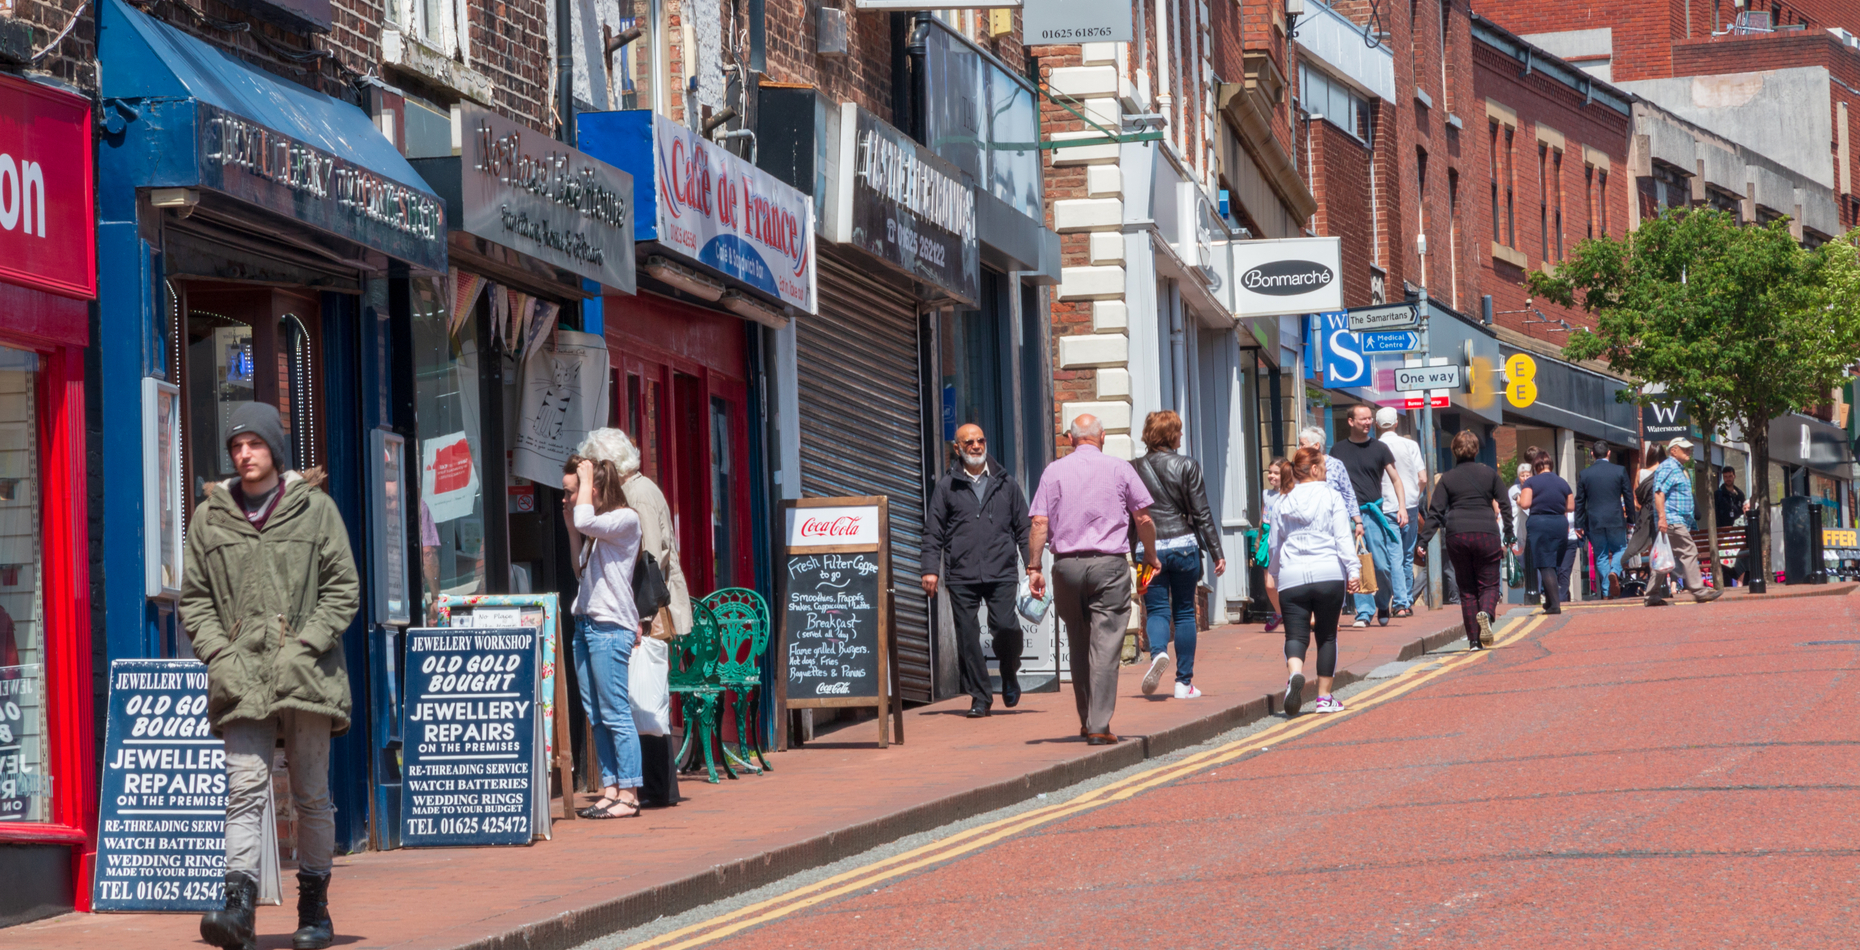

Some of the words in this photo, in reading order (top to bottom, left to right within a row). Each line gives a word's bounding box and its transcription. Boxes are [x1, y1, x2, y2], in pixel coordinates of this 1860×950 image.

[1042, 28, 1073, 39] 01625
[1075, 27, 1112, 38] 618765
[672, 137, 712, 218] Café
[718, 160, 738, 230] de
[742, 175, 799, 260] France
[897, 223, 918, 255] 01625
[919, 235, 945, 268] 262122
[1245, 268, 1331, 289] Bonmarché
[1350, 316, 1364, 325] The
[1366, 312, 1408, 324] Samaritans
[1400, 373, 1424, 384] One
[1429, 372, 1454, 384] way
[1649, 400, 1681, 424] W
[1822, 529, 1858, 547] FFER
[787, 555, 821, 580] Fresh
[823, 554, 853, 569] Filter
[853, 555, 879, 576] Coffee
[820, 570, 830, 579] to
[831, 571, 841, 582] go
[805, 612, 862, 635] Breakfast
[824, 629, 833, 638] all
[412, 636, 472, 652] JEWELLERY
[474, 634, 532, 650] WORKSHOP
[789, 641, 812, 657] Flame
[813, 642, 836, 658] grilled
[422, 655, 463, 674] OLD
[466, 654, 521, 673] GOLD
[789, 655, 800, 665] Hot
[820, 655, 839, 666] Fries
[115, 673, 184, 690] JEWELLERY
[428, 673, 516, 692] BOUGHT
[789, 666, 828, 683] Baguettes
[831, 668, 838, 677] &
[126, 694, 172, 715] OLD
[175, 694, 209, 715] GO
[410, 701, 530, 721] JEWELLERY
[131, 717, 211, 737] BOUGH
[424, 723, 515, 742] REPAIRS
[418, 744, 437, 753] ON
[441, 743, 461, 753] THE
[465, 741, 520, 752] PREMISES
[109, 749, 226, 770] JEWELLER
[408, 763, 484, 776] RE-THREADING
[486, 762, 529, 775] SERVICE
[124, 773, 226, 794] REPAIRS
[408, 780, 455, 791] WATCH
[457, 778, 528, 790] BATTERIES
[116, 795, 137, 806] ON
[142, 795, 164, 806] THE
[412, 794, 480, 806] WEDDING
[482, 793, 524, 805] RINGS
[412, 806, 439, 815] MADE
[440, 806, 456, 815] TO
[458, 805, 483, 814] YOUR
[485, 804, 524, 813] BUDGET
[104, 820, 189, 833] RE-THREADING
[191, 820, 225, 832] SERVI
[407, 818, 438, 836] TEL
[440, 817, 479, 834] 01625
[482, 816, 527, 833] 425472
[104, 838, 155, 850] WATCH
[107, 854, 180, 867] WEDDING
[106, 867, 137, 877] MADE
[138, 867, 154, 877] TO
[155, 867, 186, 877] YOUR
[100, 881, 133, 900] TEL
[137, 881, 180, 900] 01625
[183, 881, 226, 900] 42547
